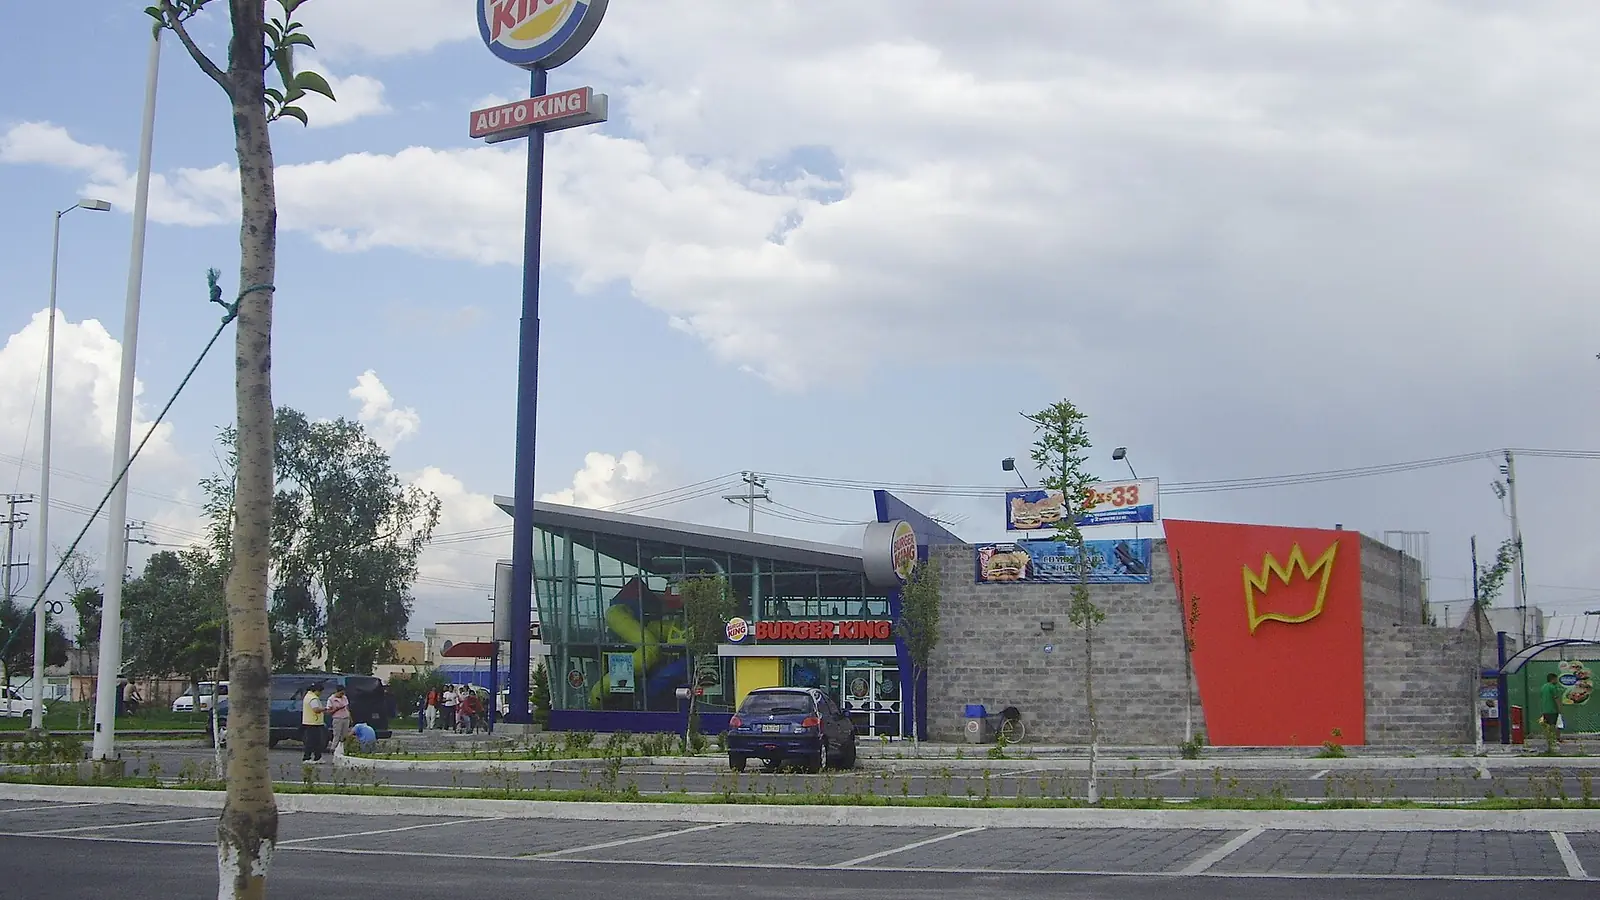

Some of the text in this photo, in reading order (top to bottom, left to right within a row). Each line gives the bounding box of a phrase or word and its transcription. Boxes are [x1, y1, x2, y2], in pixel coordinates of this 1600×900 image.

[476, 93, 581, 131] AUTO KING
[894, 544, 916, 569] KING
[728, 626, 746, 638] KING
[755, 620, 891, 641] BURGER KING
